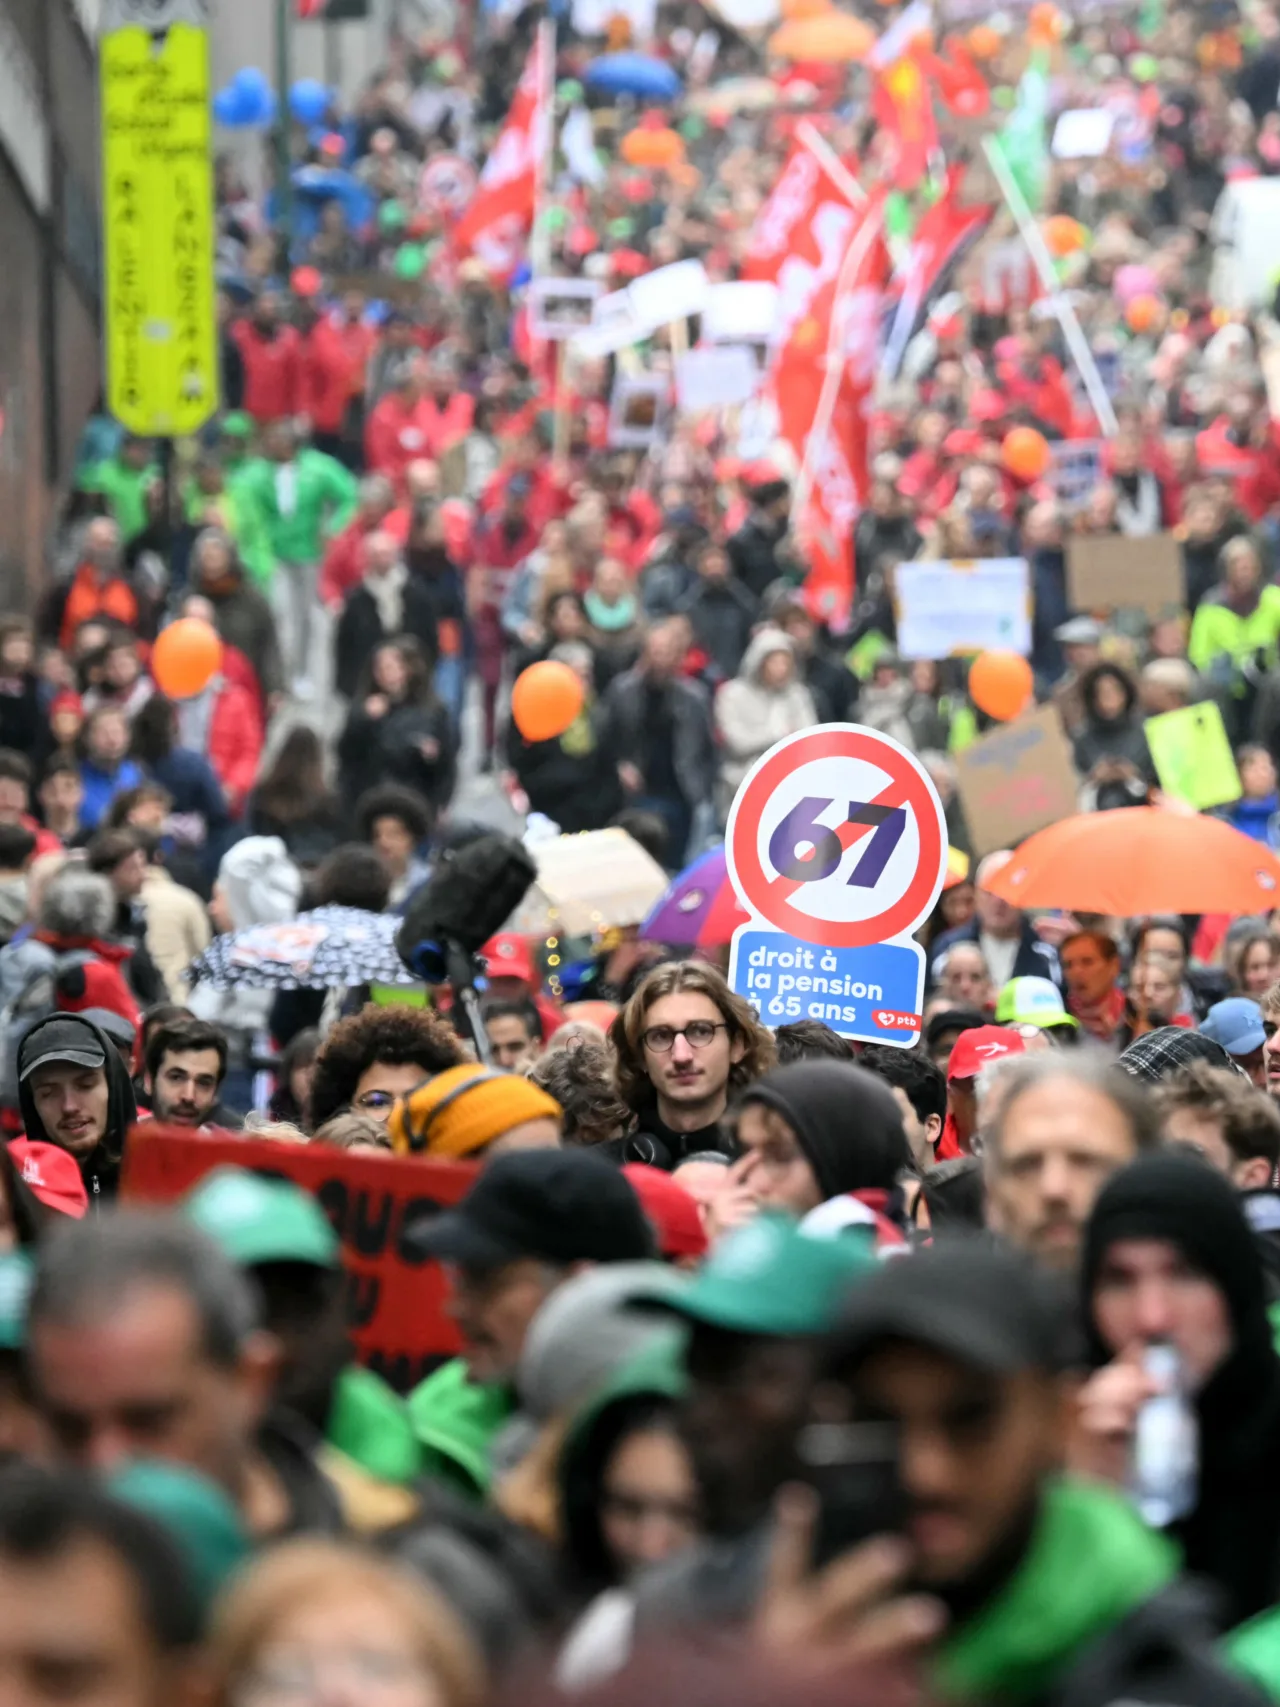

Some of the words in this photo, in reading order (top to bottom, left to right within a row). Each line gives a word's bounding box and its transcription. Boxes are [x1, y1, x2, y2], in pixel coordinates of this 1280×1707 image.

[769, 796, 907, 888] 67
[748, 946, 814, 970] droit
[820, 949, 838, 972] à
[747, 968, 772, 989] la
[777, 974, 883, 1001] pension
[768, 996, 801, 1016] 65
[807, 1001, 857, 1023] ans
[896, 1015, 917, 1026] ptb
